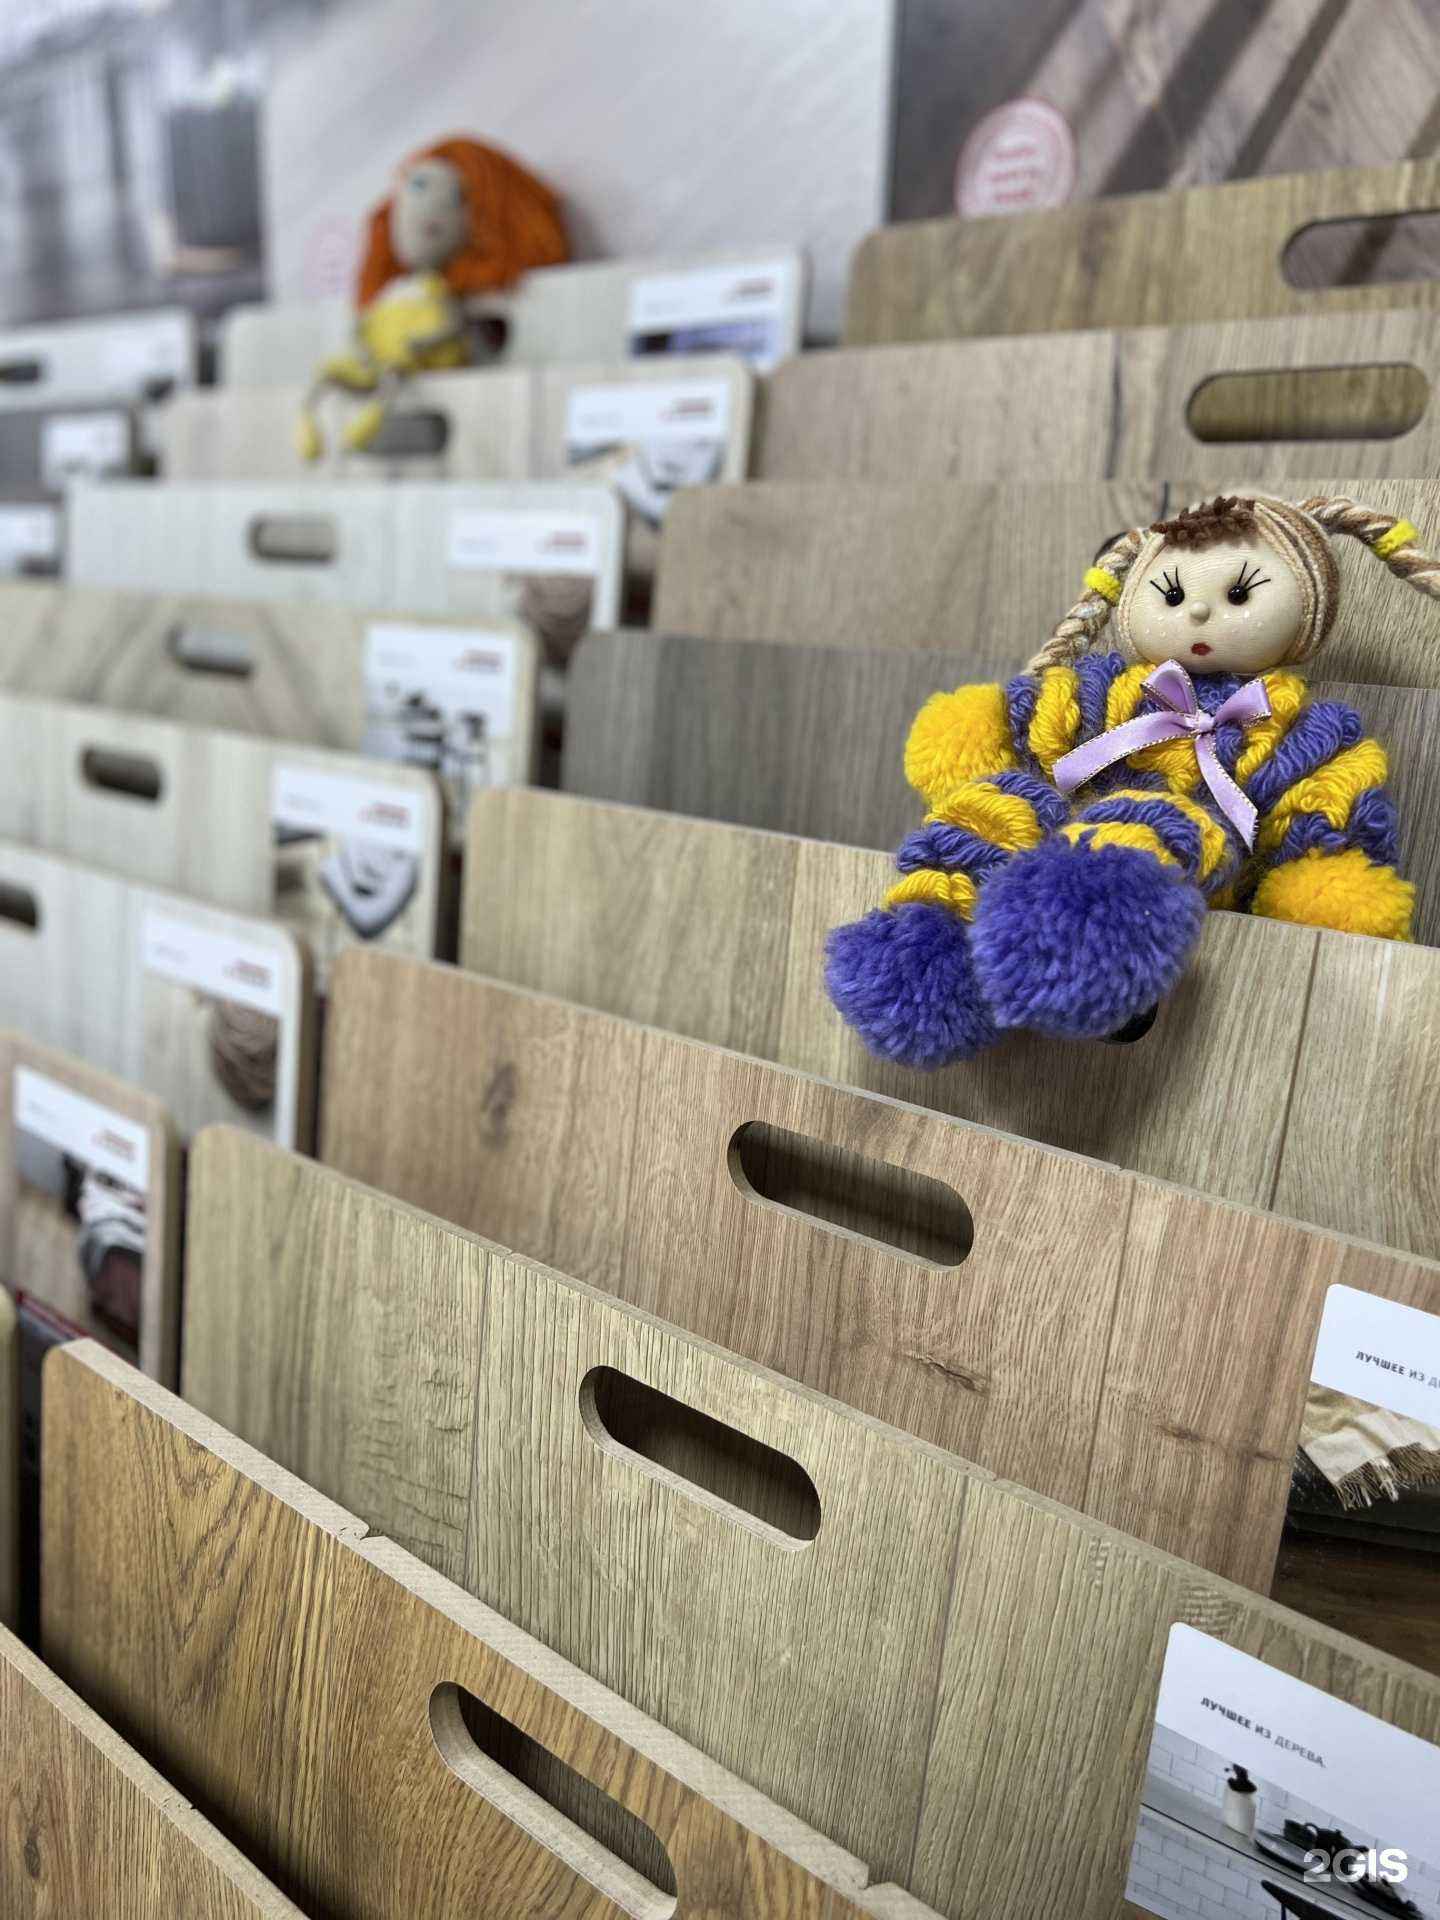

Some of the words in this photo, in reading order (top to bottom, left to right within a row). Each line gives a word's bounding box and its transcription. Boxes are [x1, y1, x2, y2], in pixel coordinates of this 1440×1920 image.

[1355, 1350, 1405, 1376] ЛУЧШЕЕ
[1409, 1368, 1425, 1382] ИЗ
[1200, 1696, 1252, 1730] ЛУЧШЕЕ
[1254, 1725, 1272, 1740] ИЗ
